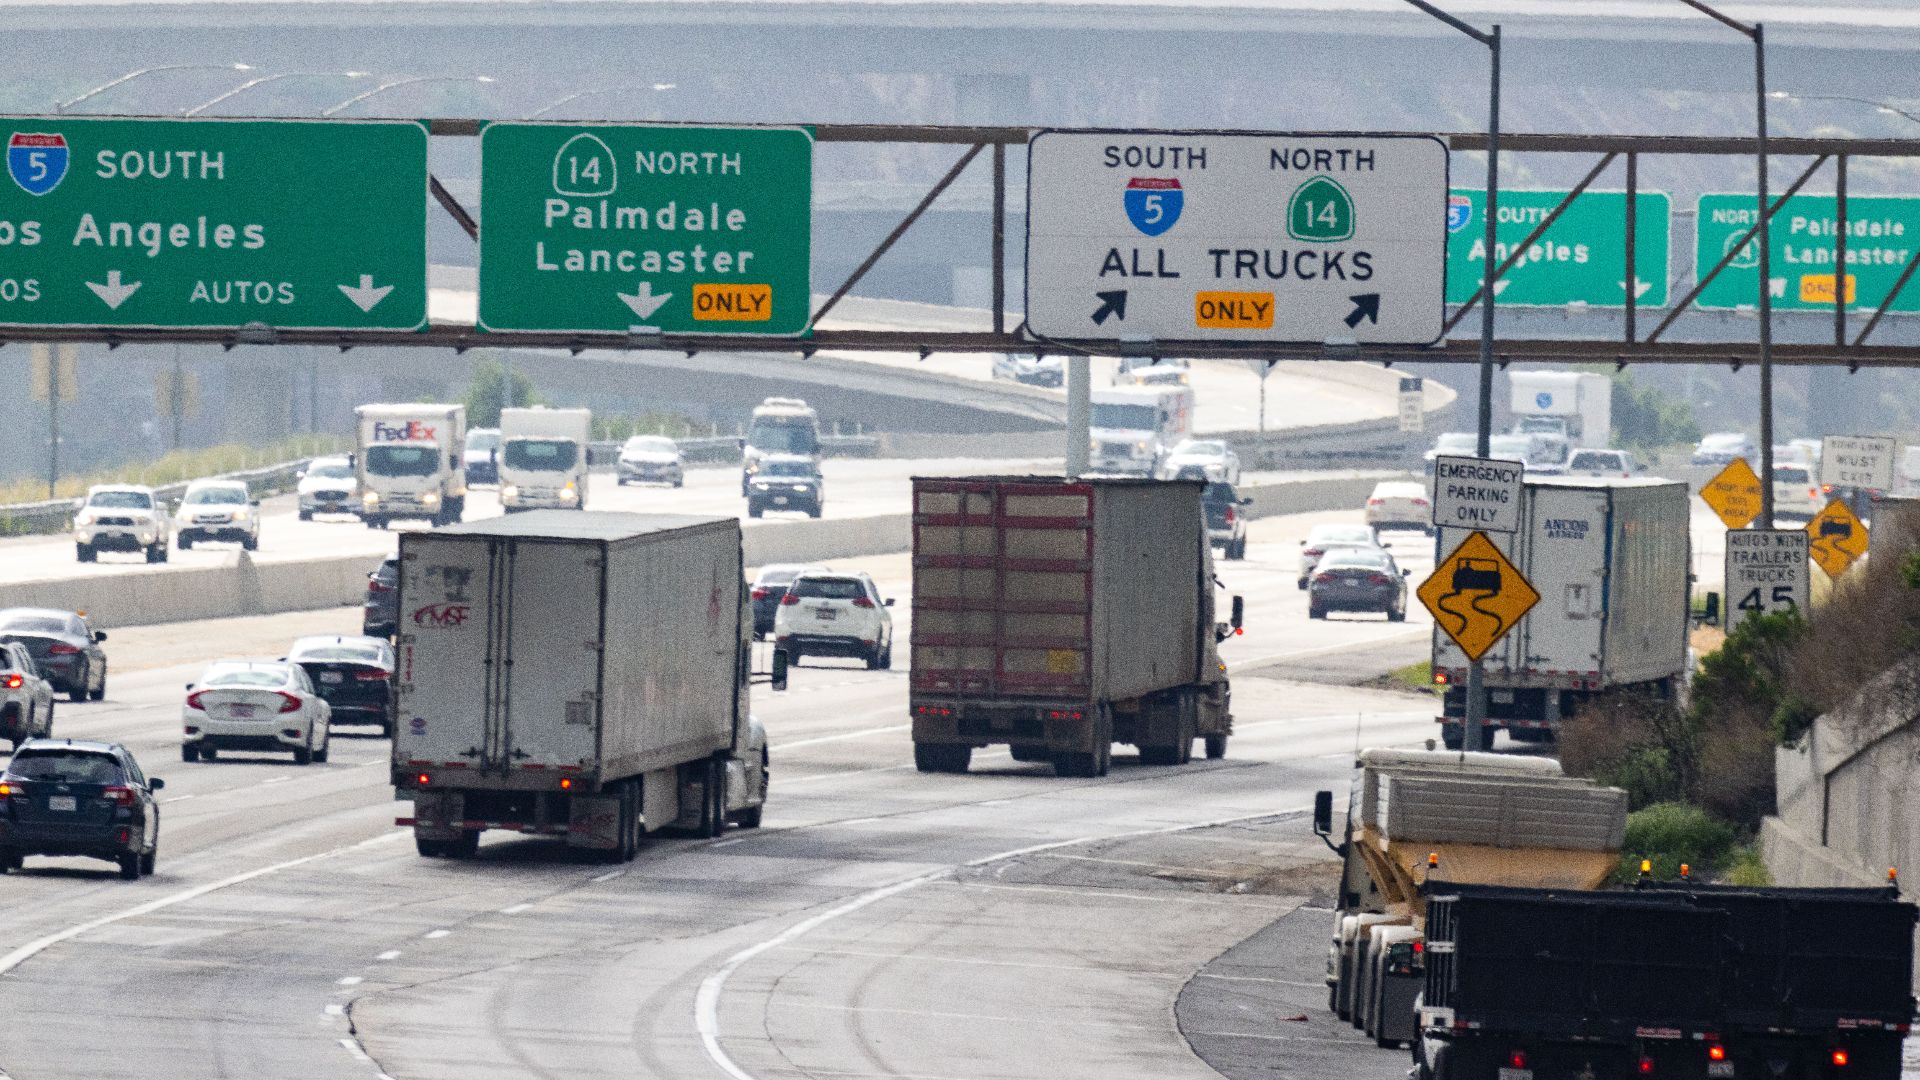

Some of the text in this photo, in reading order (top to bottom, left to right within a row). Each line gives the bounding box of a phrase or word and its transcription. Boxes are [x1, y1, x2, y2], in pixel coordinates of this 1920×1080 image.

[28, 150, 225, 182] 5 SOUTH
[569, 150, 741, 185] 14 NORTH
[1104, 145, 1208, 170] SOUTH
[1270, 148, 1375, 172] NORTH
[545, 198, 747, 231] Palmdale
[1144, 194, 1165, 225] 5
[1304, 200, 1338, 229] 14
[1711, 208, 1774, 225] NORT
[0, 213, 267, 258] os Angeles
[536, 241, 755, 274] Lancaster
[1098, 247, 1375, 281] ALL TRUCKS
[0, 278, 41, 302] OS
[189, 280, 296, 305] AUTOS
[696, 291, 768, 313] ONLY
[1199, 299, 1271, 322] ONLY
[374, 420, 436, 442] FedEx
[1440, 463, 1519, 484] EMERGENCY
[1447, 484, 1509, 504] PARKING
[1457, 506, 1498, 522] ONLY
[1733, 550, 1802, 564] TRAILERS
[1738, 569, 1796, 582] TRUCKS
[1737, 586, 1798, 615] 45
